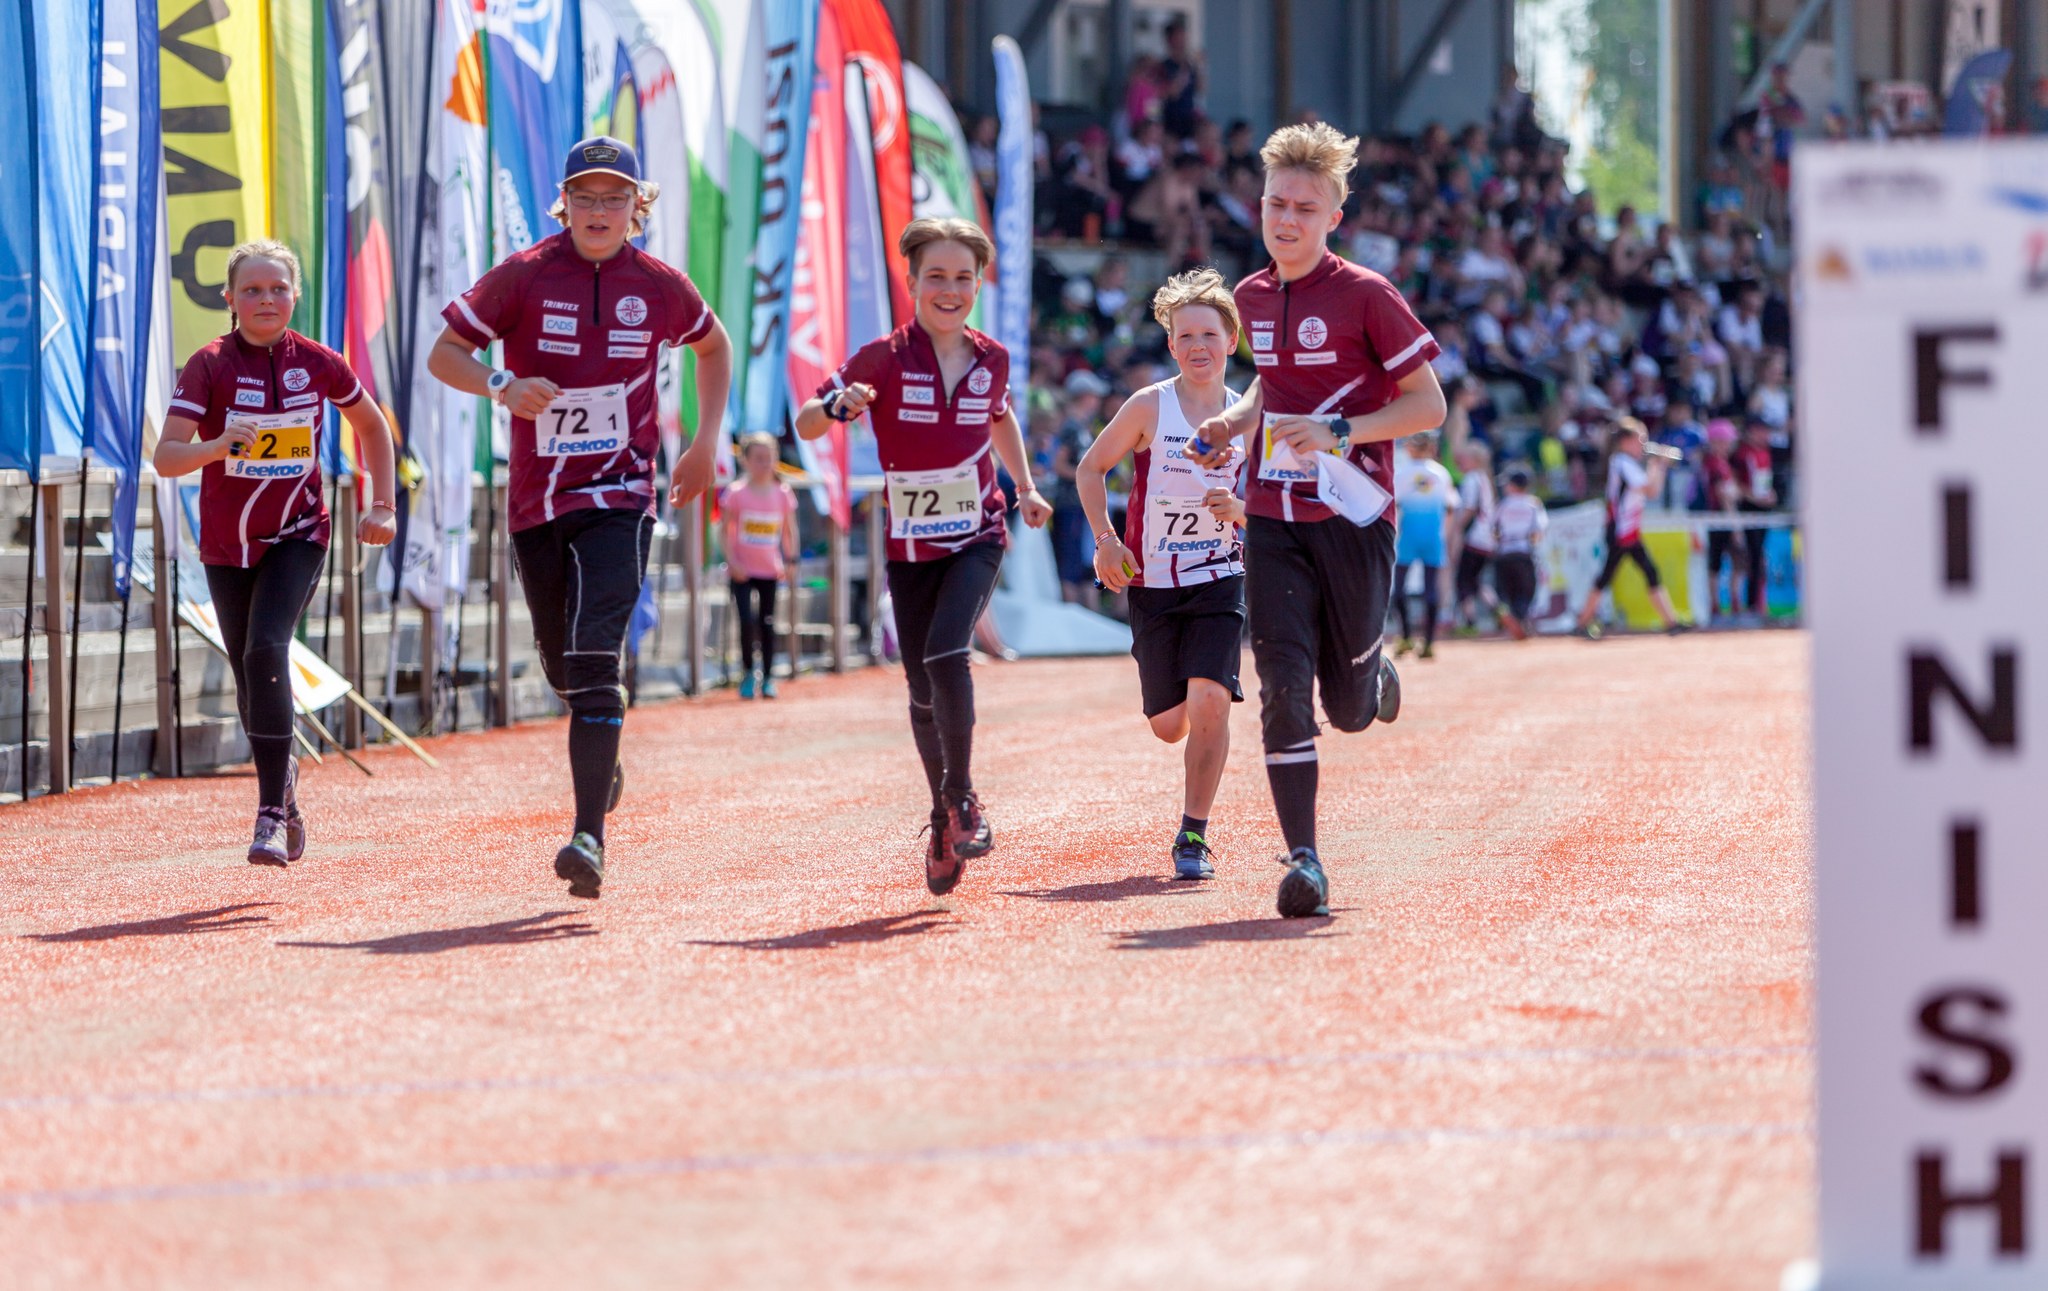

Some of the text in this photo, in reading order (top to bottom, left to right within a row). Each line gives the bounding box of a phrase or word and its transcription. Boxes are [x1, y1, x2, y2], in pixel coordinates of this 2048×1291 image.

[543, 300, 579, 311] TRIMTEX
[546, 319, 574, 332] CADS
[550, 344, 575, 352] STEVECO
[237, 376, 264, 386] TRIMTEX
[902, 372, 934, 382] TRIMTEX
[238, 392, 262, 404] CADS
[906, 390, 931, 400] CADS
[551, 408, 616, 435] 72 1
[292, 446, 310, 458] RR
[1166, 450, 1186, 459] CAD
[902, 490, 976, 517] 72 TR
[1164, 513, 1224, 536] 72 3
[1912, 322, 2025, 1260] FINISH
